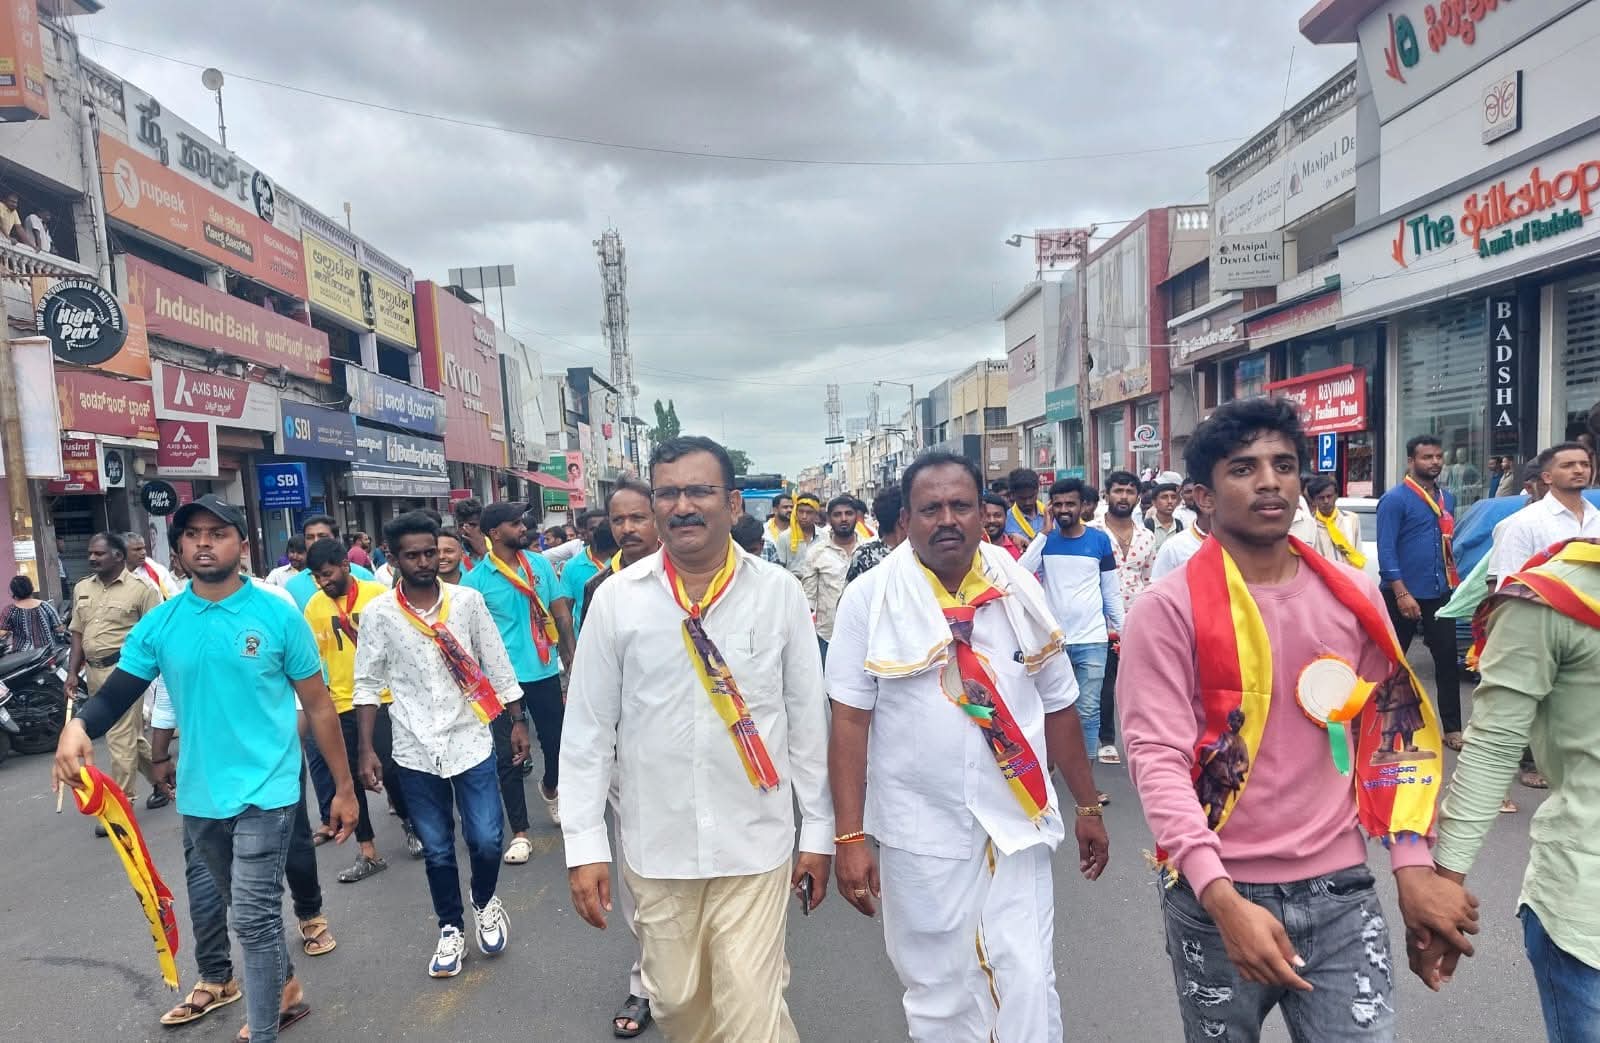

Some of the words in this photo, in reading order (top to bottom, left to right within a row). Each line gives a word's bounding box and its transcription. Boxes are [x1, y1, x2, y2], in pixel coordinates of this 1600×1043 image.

[141, 178, 187, 215] rupeek
[1406, 213, 1455, 256] The
[1460, 160, 1600, 250] Silkshop
[1515, 222, 1530, 246] of
[78, 280, 93, 291] BAR
[57, 308, 95, 327] High
[155, 287, 224, 336] IndusInd
[226, 314, 259, 347] Bank
[60, 324, 100, 340] Park
[1496, 302, 1513, 427] BADSHA
[192, 381, 211, 396] AXIS
[213, 385, 235, 400] BANK
[1318, 375, 1355, 403] Raymond
[128, 400, 151, 424] ಬ್ಯಾಂಕ್
[1315, 403, 1338, 420] Fashion
[1340, 400, 1358, 416] Point
[294, 417, 311, 440] SBI
[1323, 435, 1332, 456] P
[277, 474, 298, 487] SBI
[148, 491, 168, 501] High
[150, 498, 170, 507] Park
